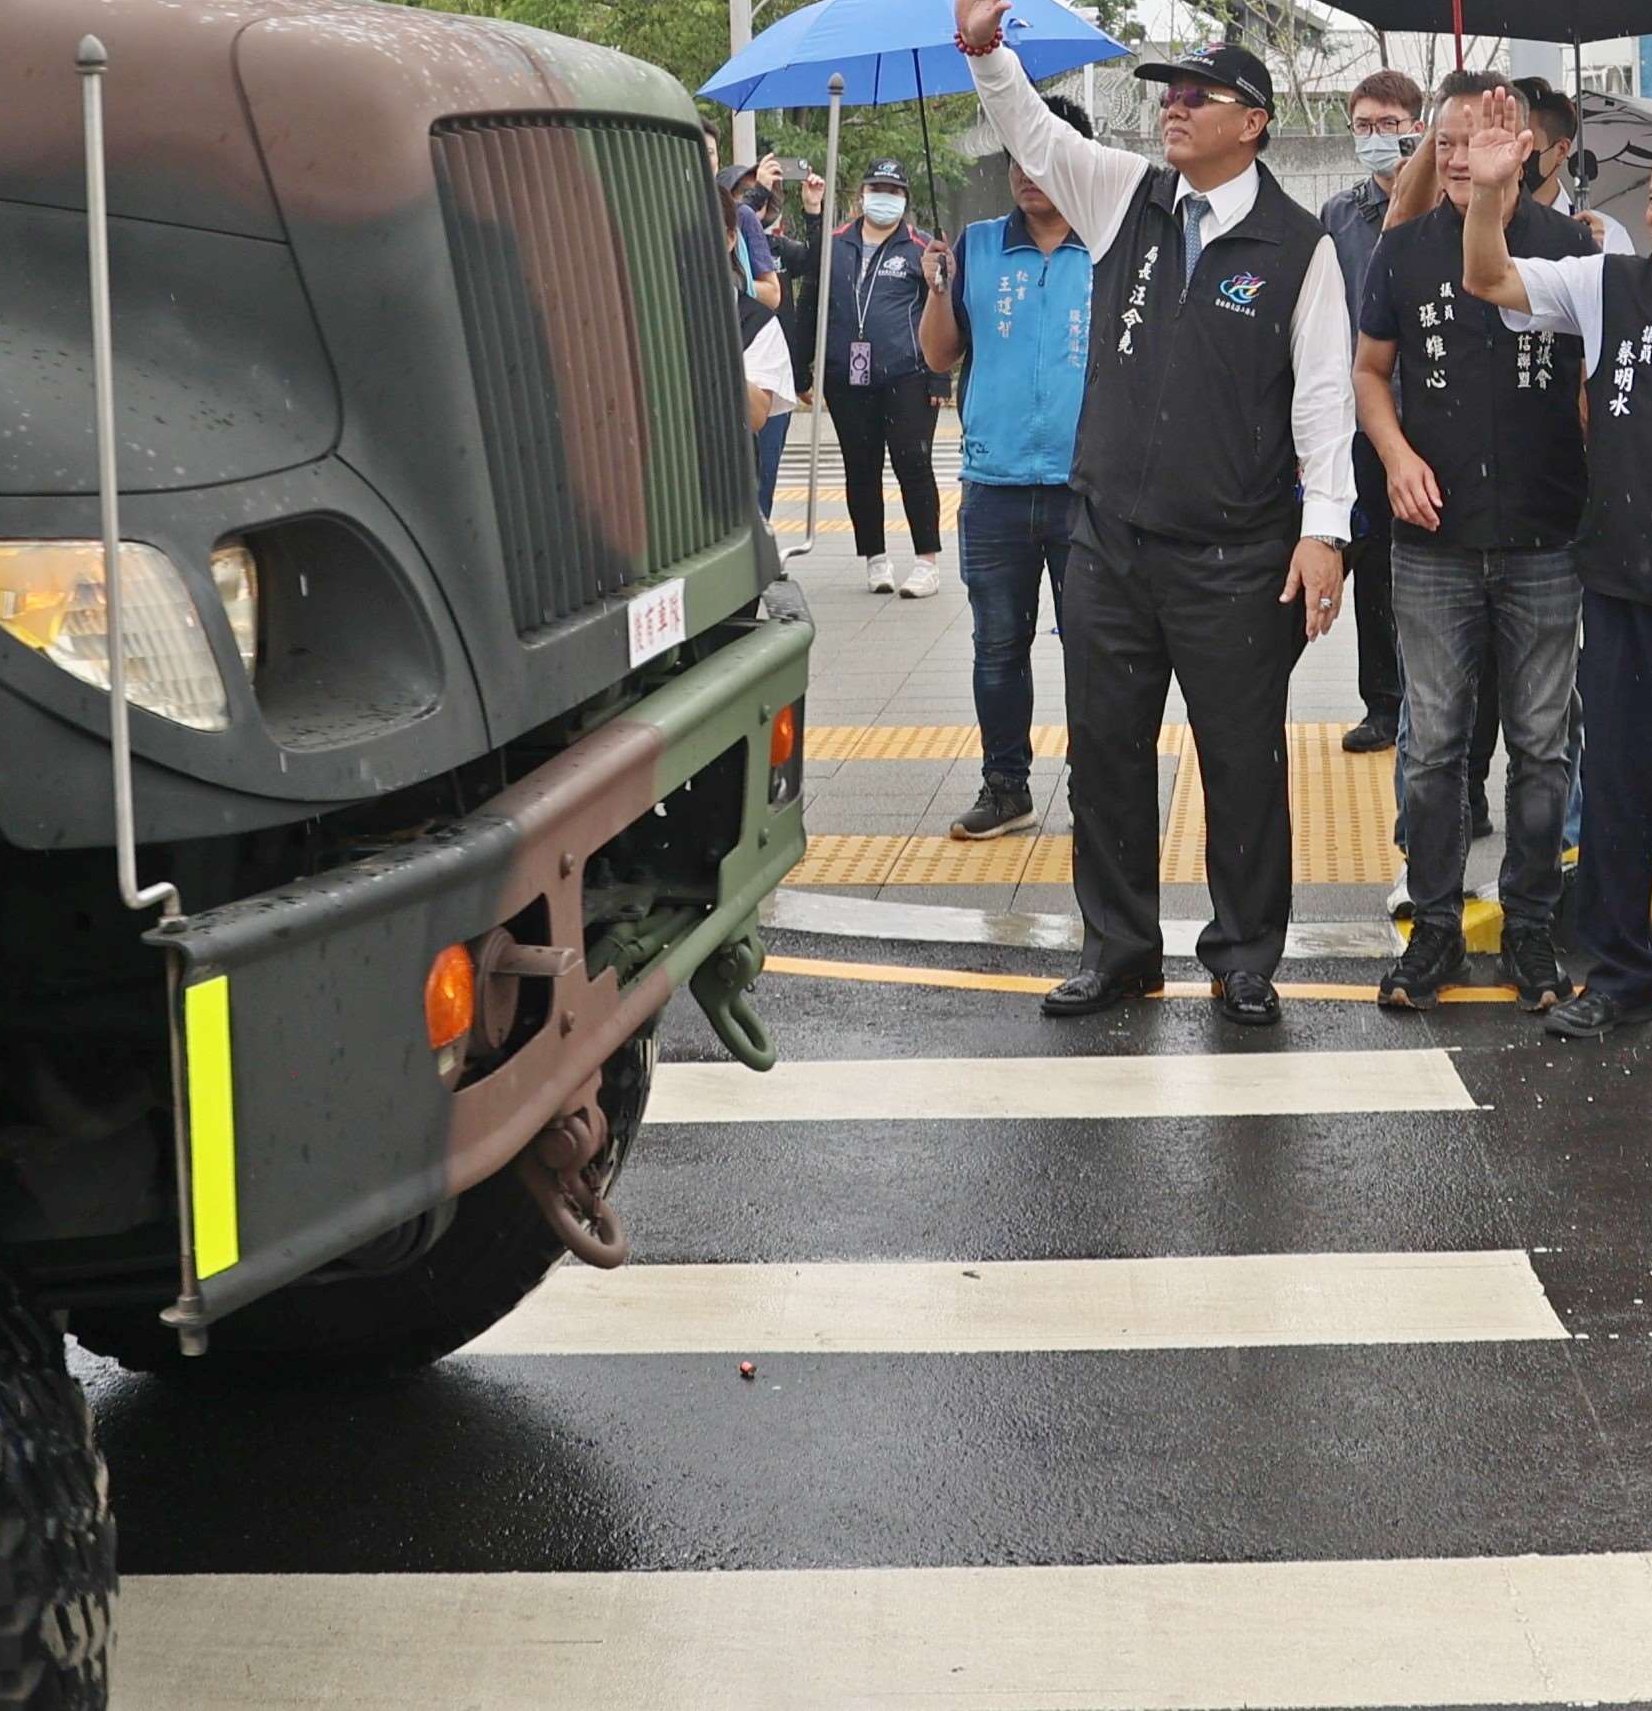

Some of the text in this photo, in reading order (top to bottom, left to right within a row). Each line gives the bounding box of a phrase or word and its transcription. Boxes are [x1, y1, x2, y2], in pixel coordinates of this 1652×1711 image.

[1439, 281, 1455, 321] 議員
[1608, 339, 1637, 417] 蔡明水
